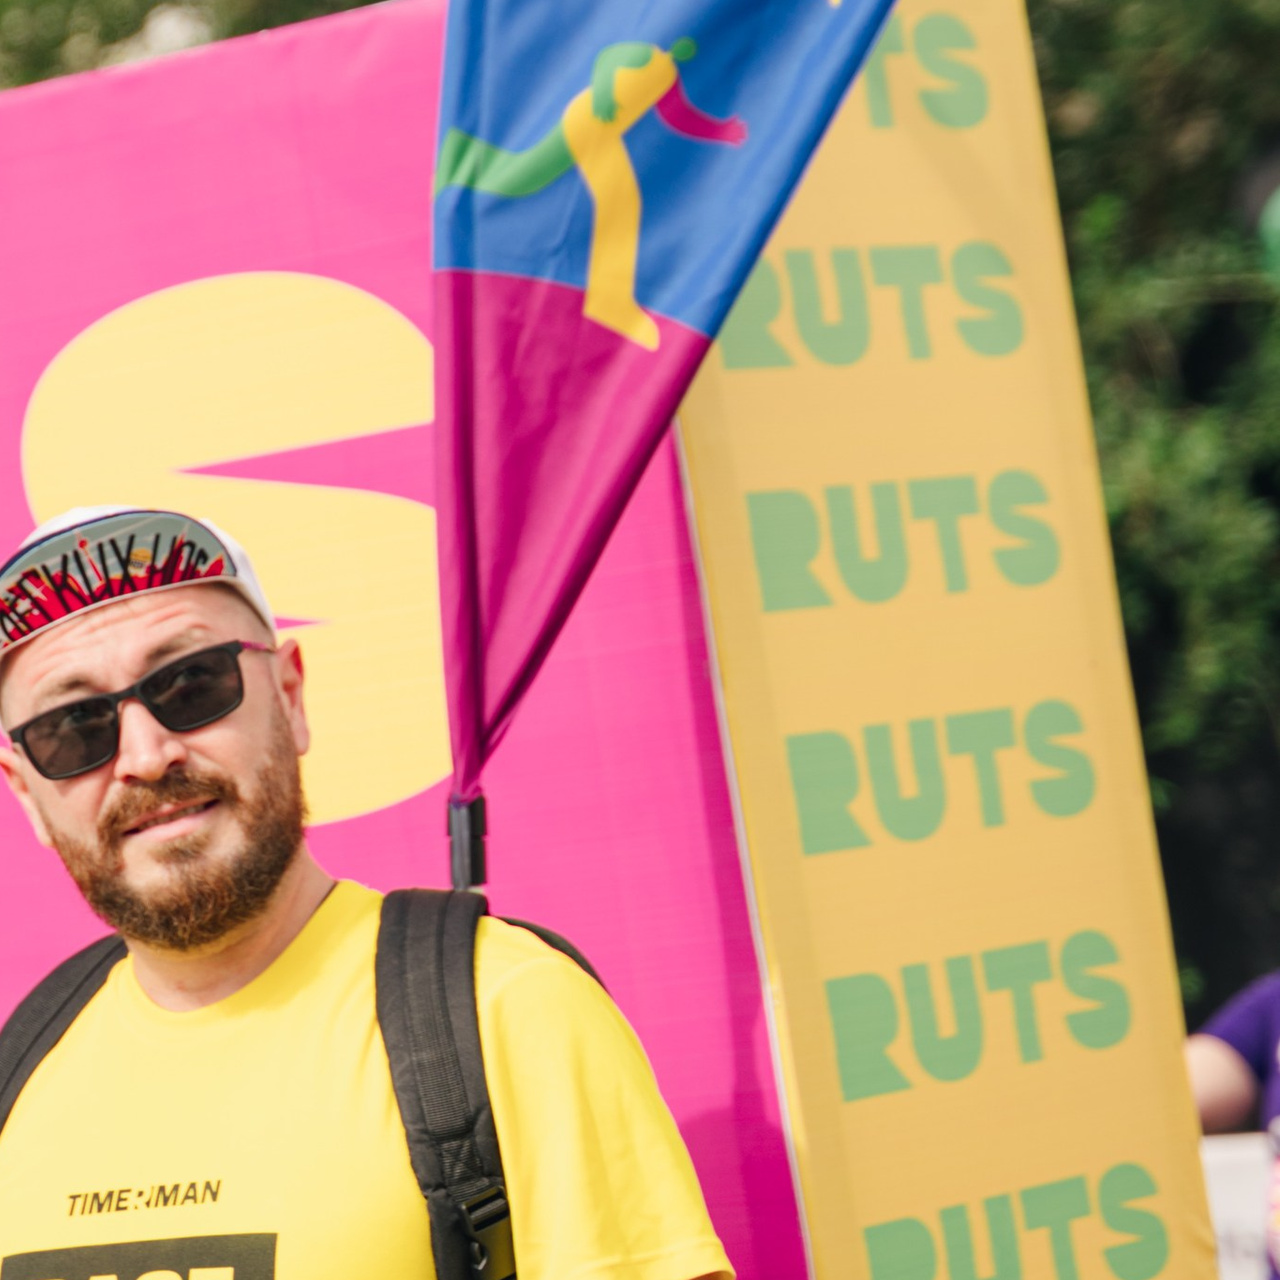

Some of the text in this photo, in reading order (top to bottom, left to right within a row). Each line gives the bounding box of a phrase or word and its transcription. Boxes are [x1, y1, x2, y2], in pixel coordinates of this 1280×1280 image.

[865, 12, 990, 128] TS
[718, 239, 1025, 370] RUTS
[744, 469, 1061, 612] RUTS
[784, 698, 1096, 856] RUTS
[824, 929, 1131, 1102] RUTS
